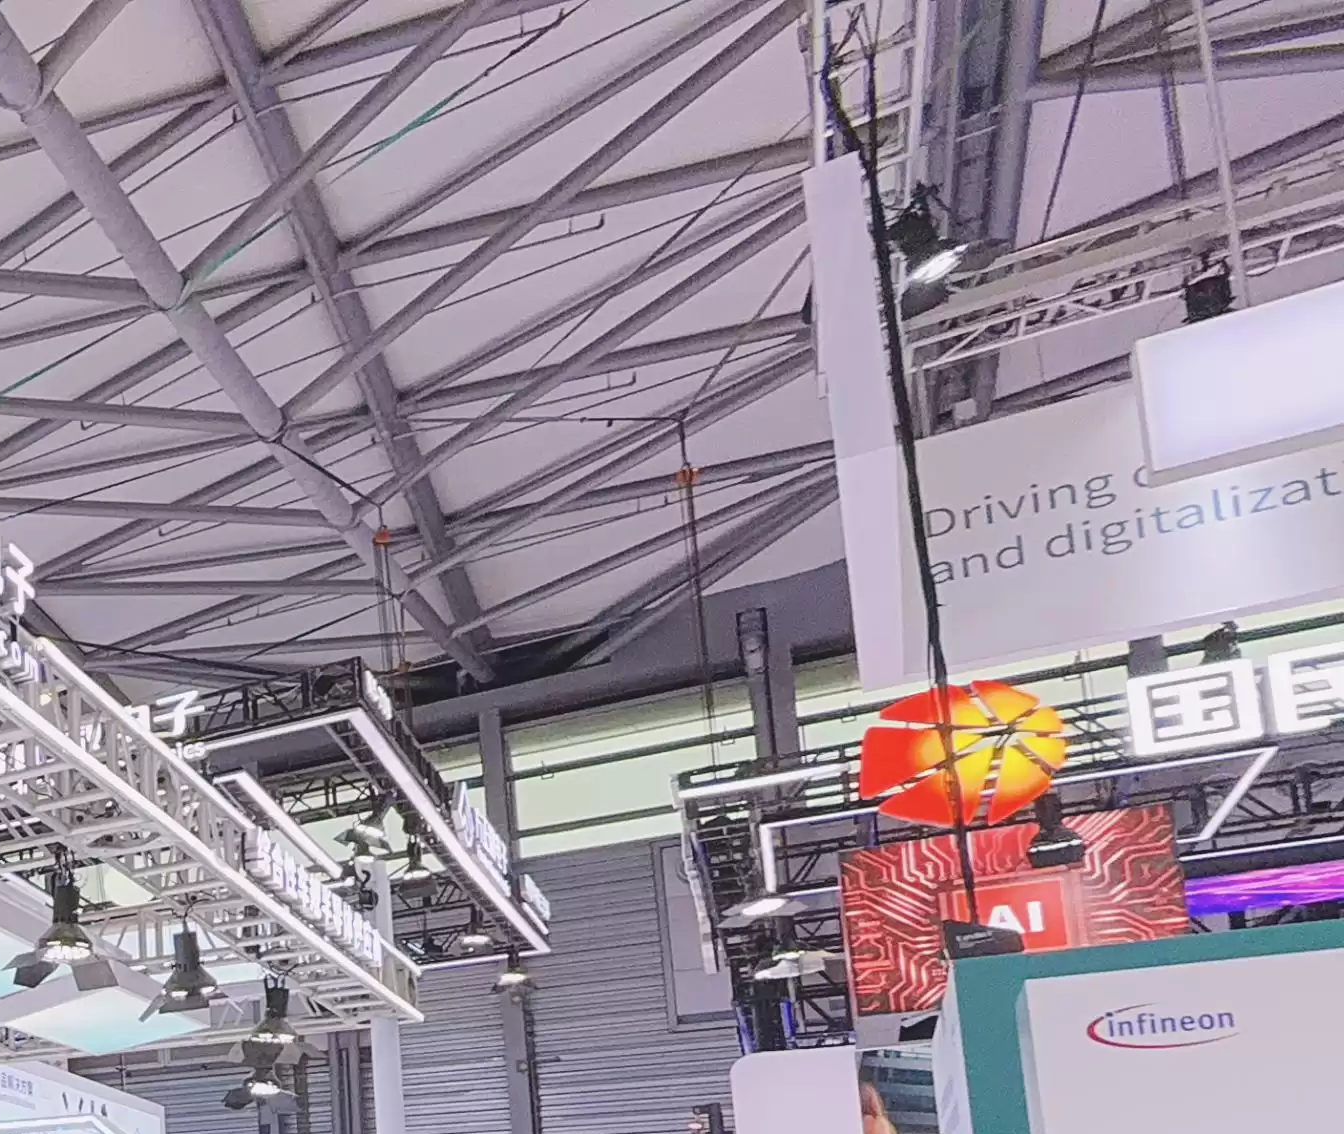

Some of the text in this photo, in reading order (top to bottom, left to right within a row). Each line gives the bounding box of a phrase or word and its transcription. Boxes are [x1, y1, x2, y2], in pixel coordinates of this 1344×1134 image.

[923, 471, 1118, 539] Driving
[928, 458, 1344, 585] and digitalizat
[987, 899, 1046, 935] AI
